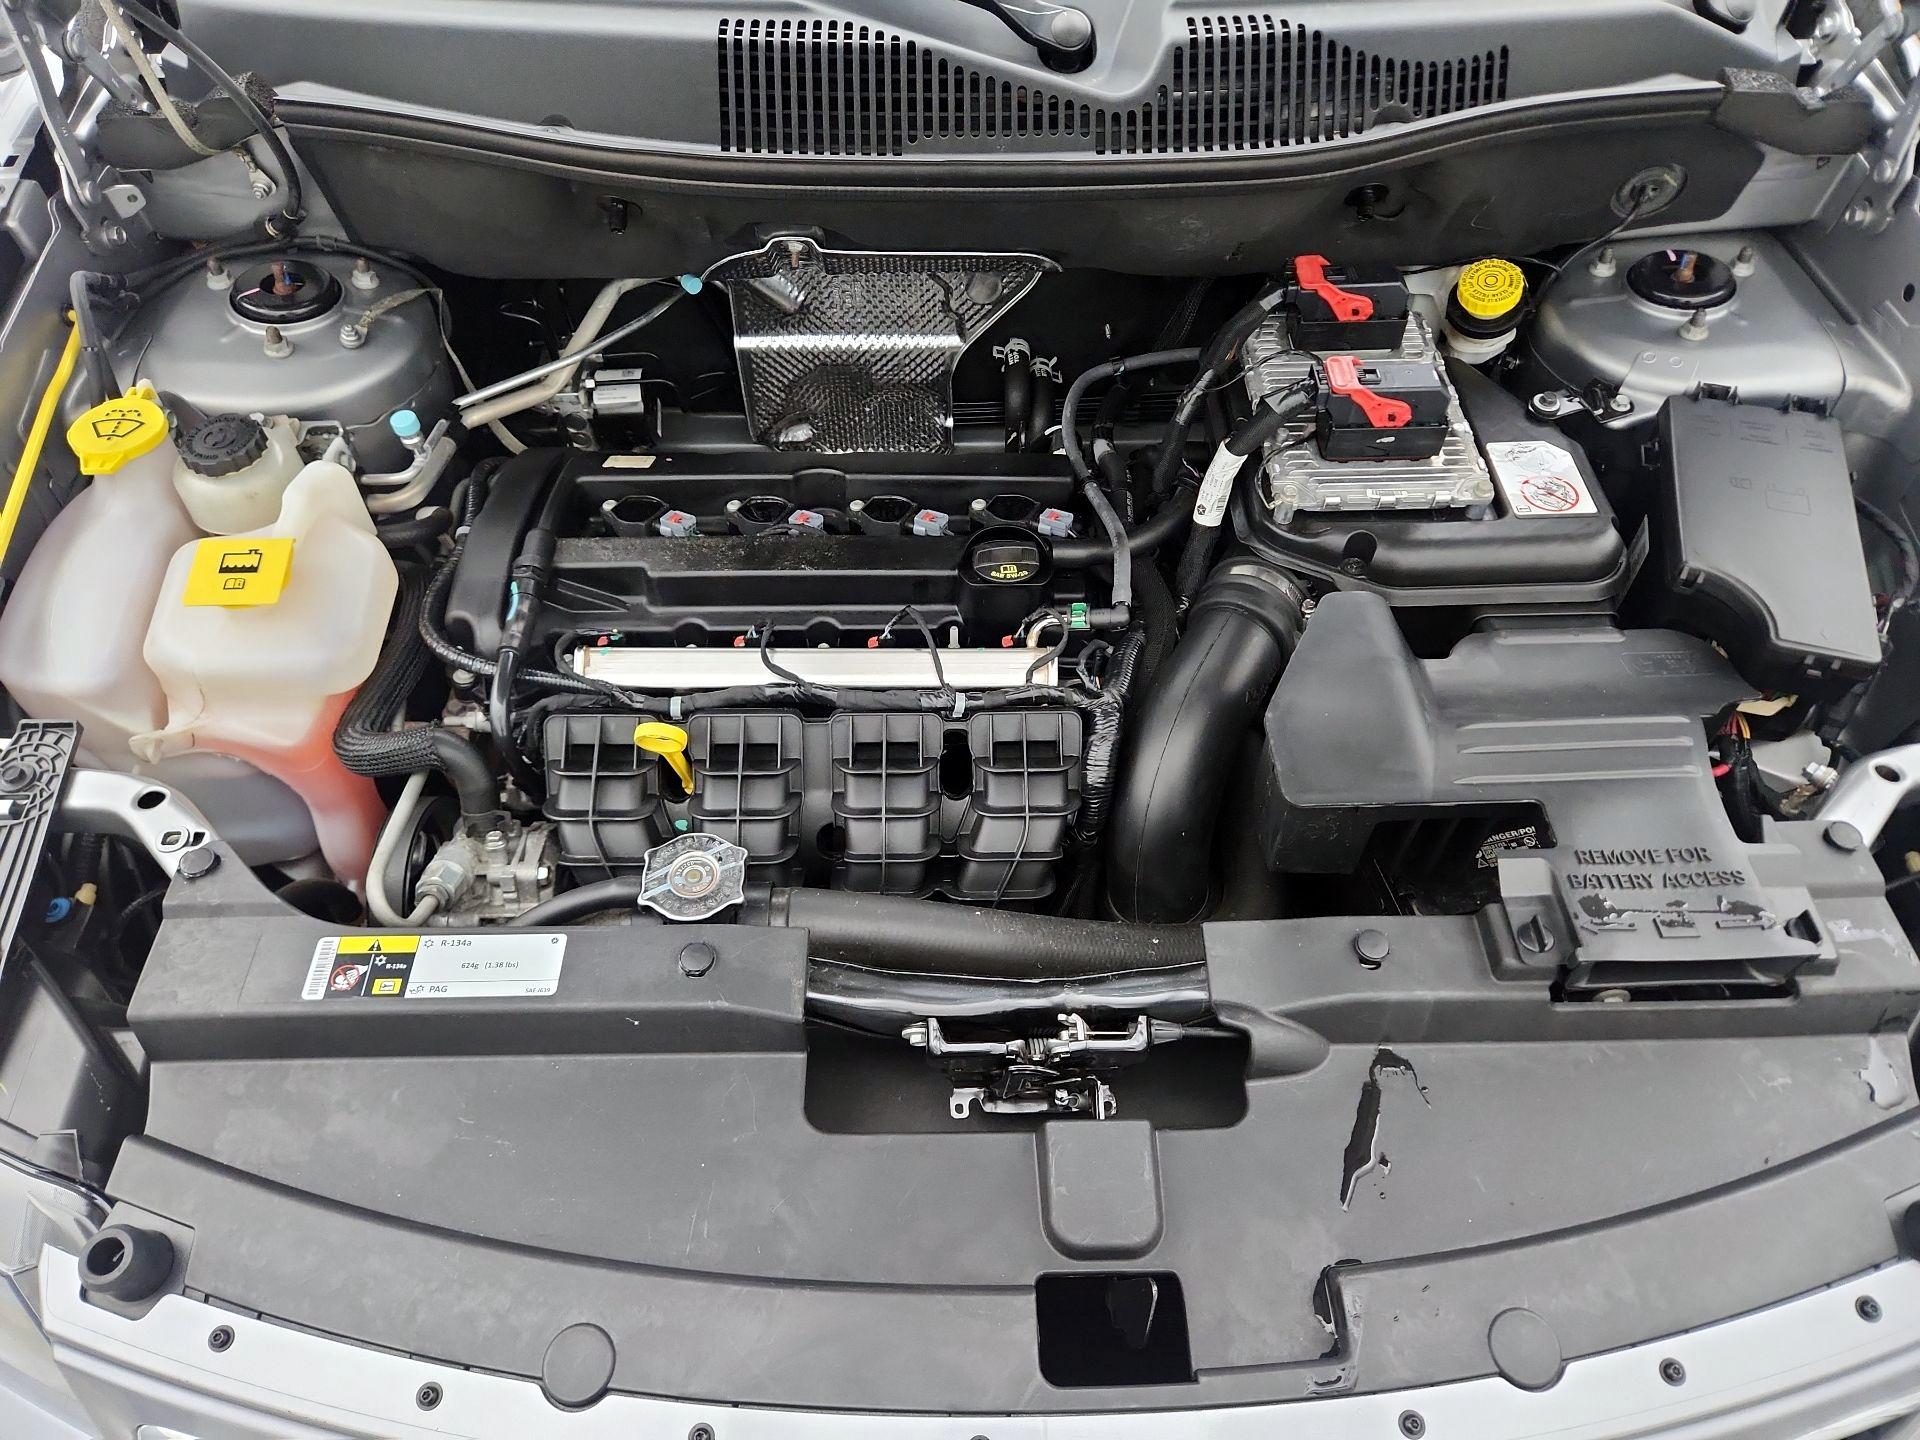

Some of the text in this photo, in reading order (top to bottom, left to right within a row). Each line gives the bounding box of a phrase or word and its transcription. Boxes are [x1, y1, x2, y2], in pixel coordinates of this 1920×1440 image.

[1574, 846, 1713, 865] REMOVE FOR
[1567, 870, 1746, 890] BATTERY ACCESS
[440, 939, 472, 947] R-134a
[461, 961, 519, 970] 624g (1.38 lbs)
[429, 985, 448, 993] PAG
